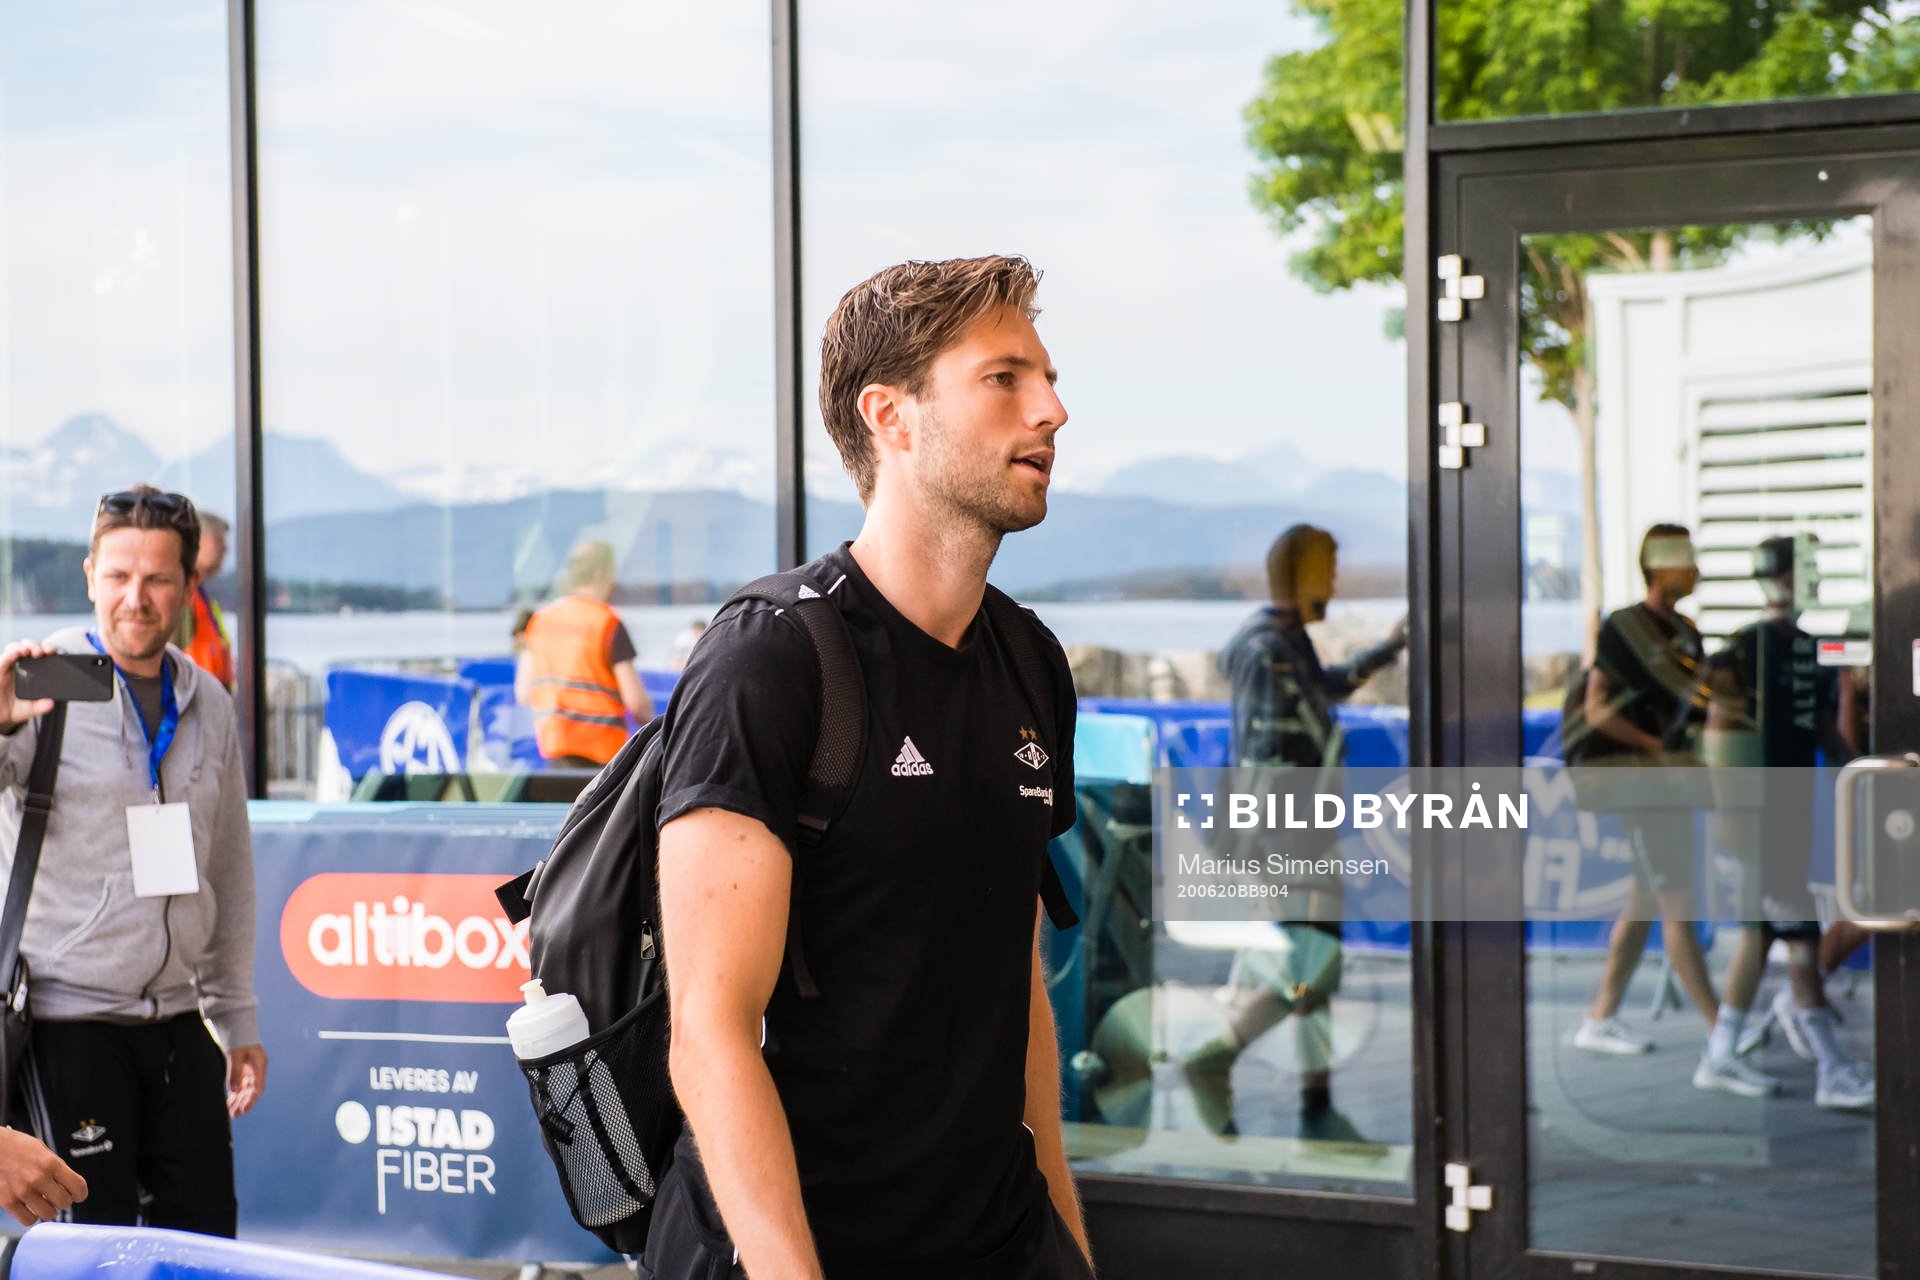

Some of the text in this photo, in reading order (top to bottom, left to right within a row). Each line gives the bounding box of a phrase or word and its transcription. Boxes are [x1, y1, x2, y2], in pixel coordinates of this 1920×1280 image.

[891, 761, 934, 777] adidas
[308, 896, 531, 969] altibox
[370, 1066, 479, 1094] LEVERES AV
[375, 1105, 495, 1150] ISTAD
[376, 1148, 496, 1215] FIBER
